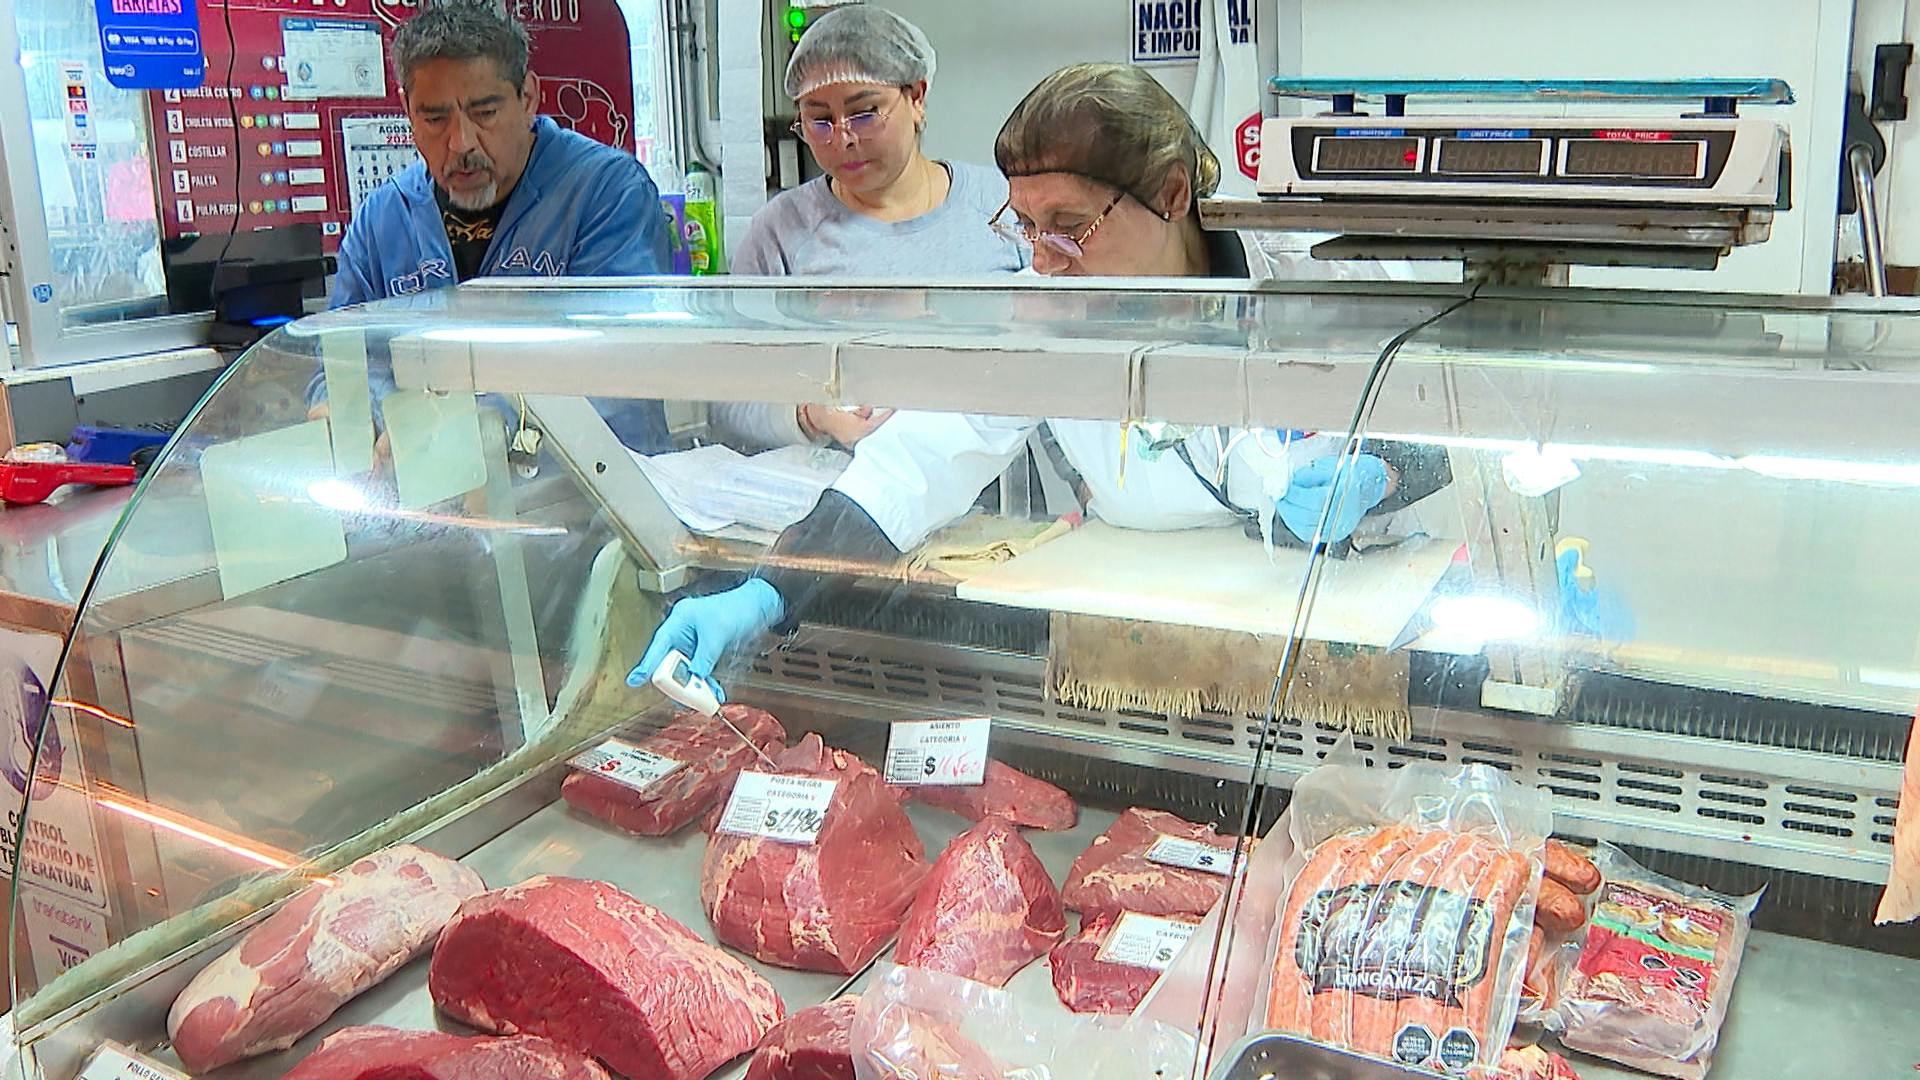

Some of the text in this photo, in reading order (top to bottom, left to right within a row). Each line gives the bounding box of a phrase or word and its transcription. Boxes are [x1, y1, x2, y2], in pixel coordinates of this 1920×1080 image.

[1138, 0, 1250, 31] NACIAL
[1138, 28, 1249, 53] E IMPODA
[171, 113, 179, 129] 3
[1606, 131, 1660, 141] TOTAL PRICE
[175, 143, 227, 160] 4 COSTILLAR
[178, 173, 217, 190] 5 PALETA
[195, 205, 219, 217] PULPA
[930, 722, 961, 730] ASIENTO
[920, 734, 961, 744] CATEGORIA
[924, 756, 937, 777] $
[770, 776, 823, 788] POSTA NEGRA
[8, 809, 68, 845] CTROL
[1, 846, 94, 894] TEPERATURA
[1335, 971, 1437, 996] LONGANIZA
